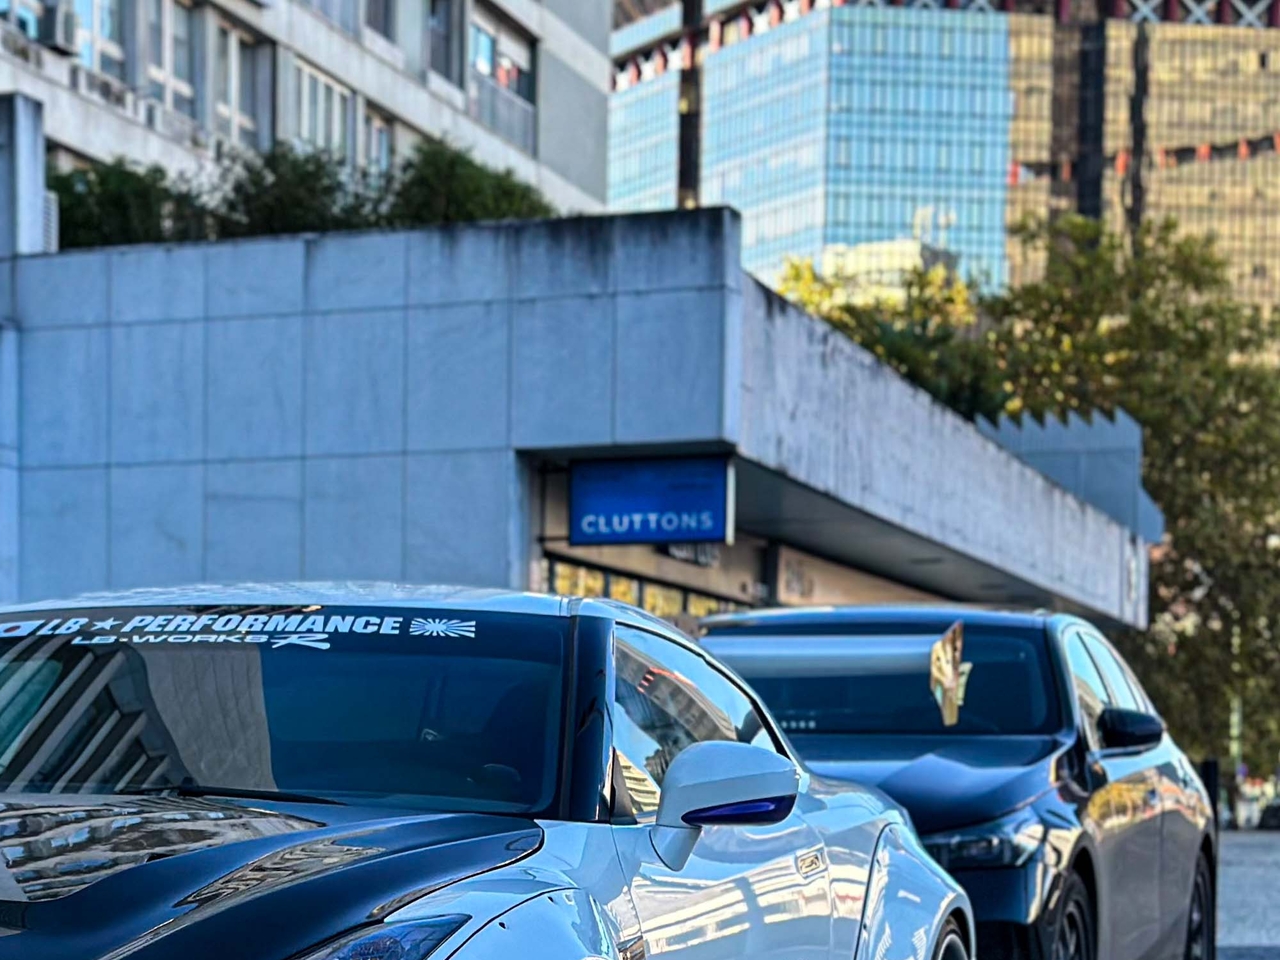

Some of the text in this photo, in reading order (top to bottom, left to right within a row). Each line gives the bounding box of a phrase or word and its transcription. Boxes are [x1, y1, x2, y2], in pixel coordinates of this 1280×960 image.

[581, 511, 714, 533] CLUTTONS
[36, 614, 403, 635] LB PERFORMANCE
